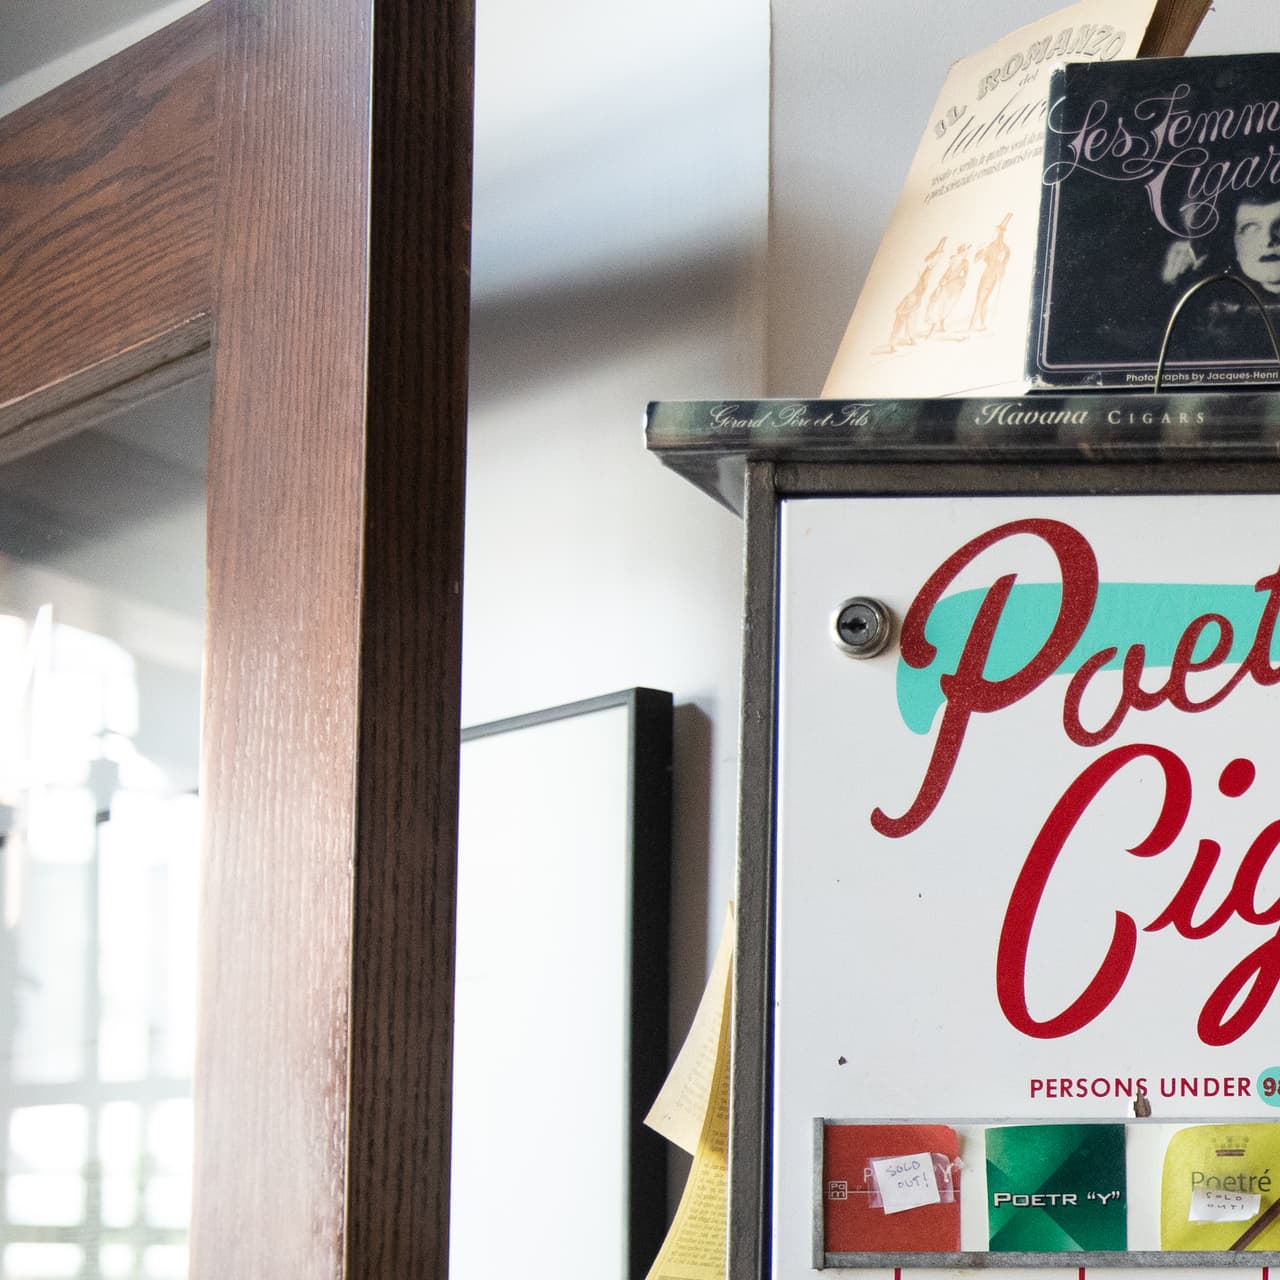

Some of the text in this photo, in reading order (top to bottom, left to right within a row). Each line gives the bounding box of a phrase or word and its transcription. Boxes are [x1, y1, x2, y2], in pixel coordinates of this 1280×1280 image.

[976, 24, 1126, 100] ROMANZO
[1043, 97, 1150, 185] Les
[1126, 373, 1190, 383] Photoraphs
[1192, 373, 1205, 383] by
[1207, 370, 1279, 382] Jacques-Henri
[831, 403, 877, 427] Fils
[974, 402, 1090, 425] Havana
[1031, 1078, 1148, 1098] PERSONS
[1161, 1077, 1251, 1097] UNDER
[886, 1160, 921, 1177] SOLD
[897, 1174, 929, 1189] OUT!
[1191, 1169, 1272, 1193] Poetré
[993, 1192, 1077, 1207] POETR
